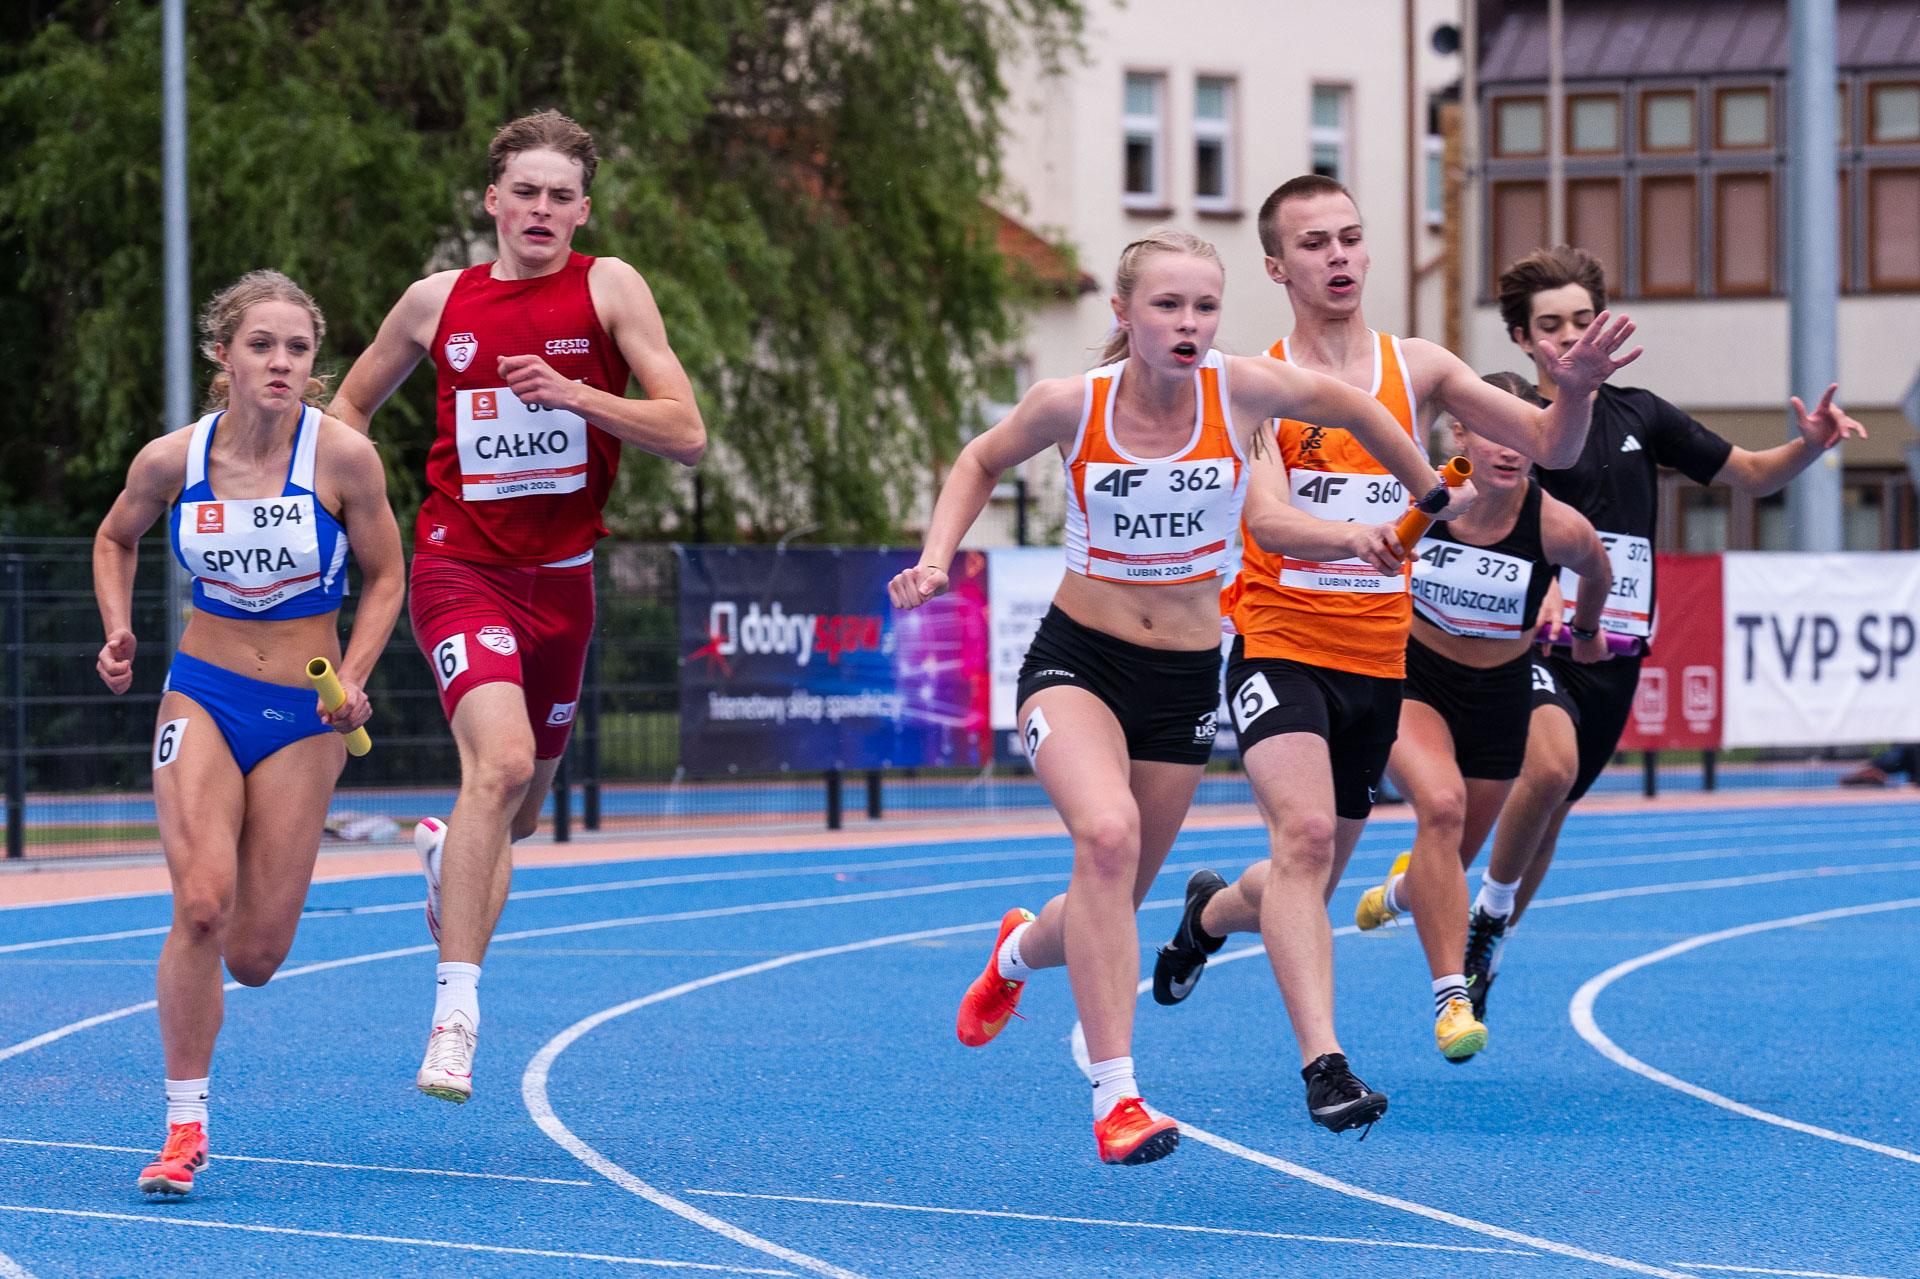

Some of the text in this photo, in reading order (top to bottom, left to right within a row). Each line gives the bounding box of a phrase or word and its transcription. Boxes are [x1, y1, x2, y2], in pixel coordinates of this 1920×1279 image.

[475, 430, 568, 460] CAŁKO
[496, 481, 557, 495] LUBIN 2026
[1094, 466, 1221, 497] 4F 362
[1297, 475, 1402, 504] 4F 360
[253, 503, 302, 528] 894
[1114, 510, 1206, 540] PATEK
[203, 547, 297, 574] SPYRA
[1126, 564, 1193, 577] LUBIN 2026
[1420, 544, 1519, 583] 4F 373
[1318, 577, 1381, 588] LUBIN 2026
[1411, 577, 1519, 615] PIETRUSZCZAK
[258, 591, 284, 607] 2026
[440, 641, 456, 679] 6
[1735, 613, 1917, 683] TVP SP
[1239, 681, 1263, 719] 5
[158, 723, 176, 763] 6
